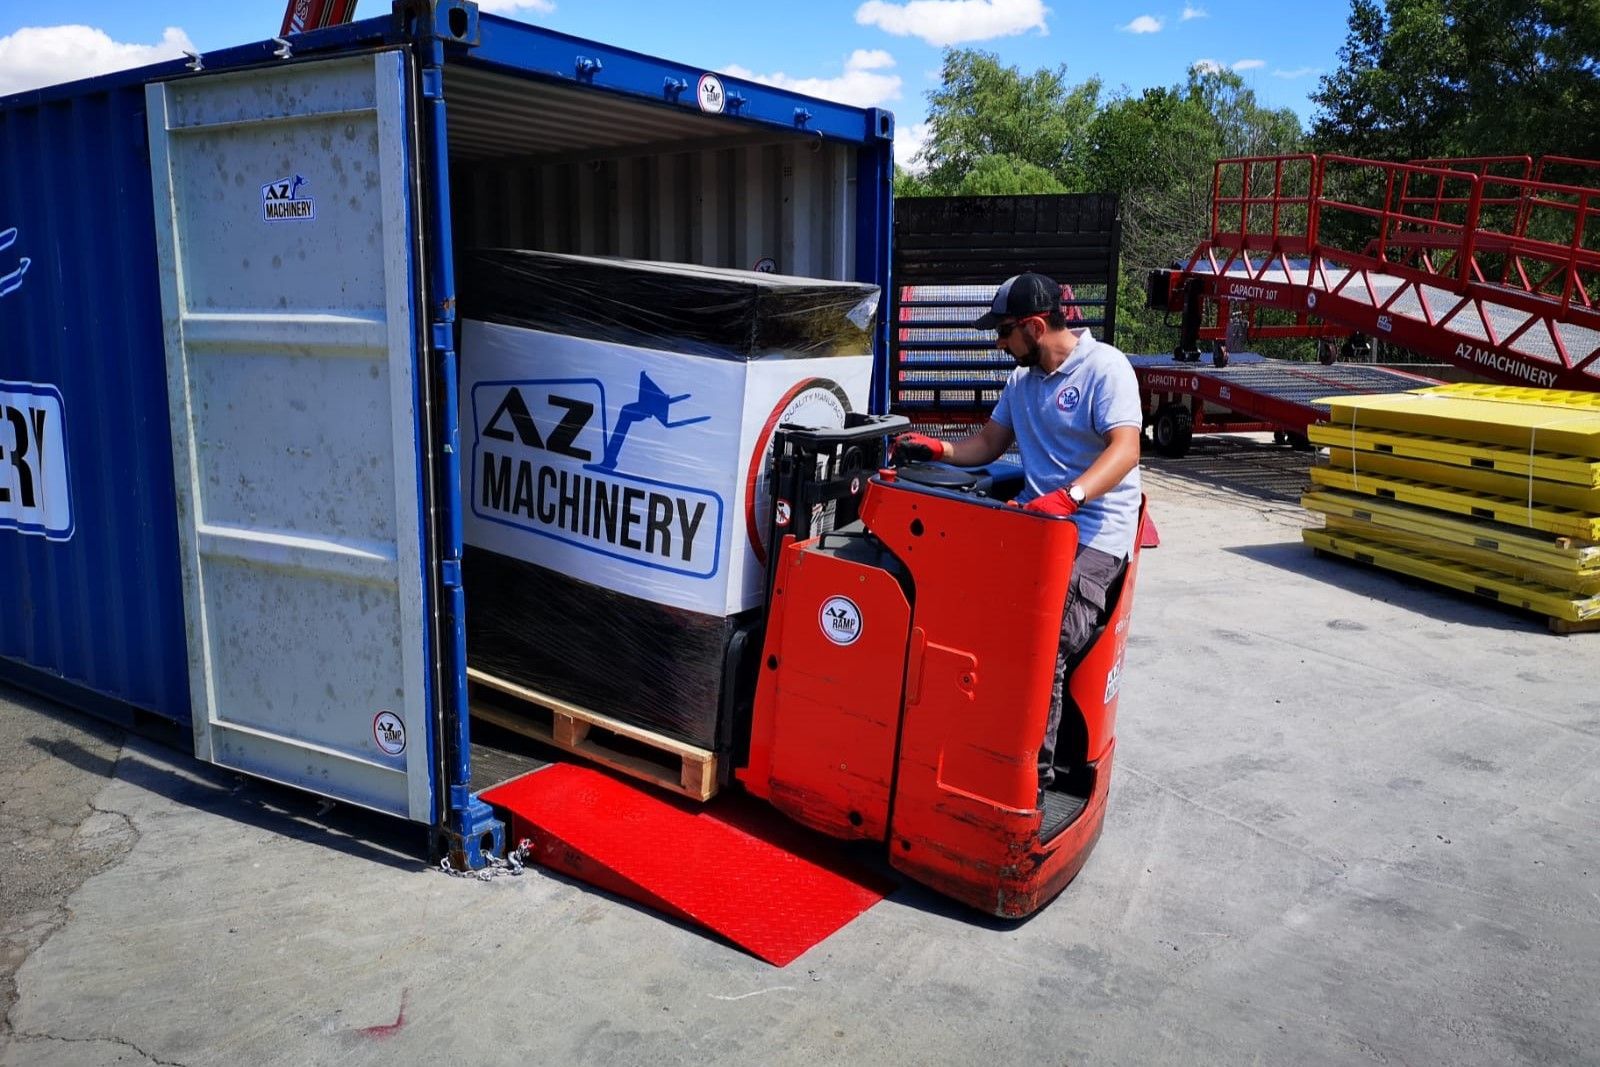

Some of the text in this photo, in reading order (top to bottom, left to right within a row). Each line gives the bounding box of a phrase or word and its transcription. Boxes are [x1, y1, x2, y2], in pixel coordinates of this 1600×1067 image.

[266, 184, 289, 199] AZ
[266, 201, 311, 218] MACHINERY
[1230, 283, 1264, 298] CAPACITY
[1455, 342, 1558, 388] AZ MACHINERY
[1147, 373, 1177, 387] CAPACITY
[784, 394, 814, 422] QUALITY
[482, 386, 594, 462] AZ
[482, 452, 707, 562] MACHINERY
[825, 607, 848, 619] AZ
[832, 618, 856, 630] RAMP
[378, 721, 393, 732] AZ
[384, 729, 402, 742] RAMP
